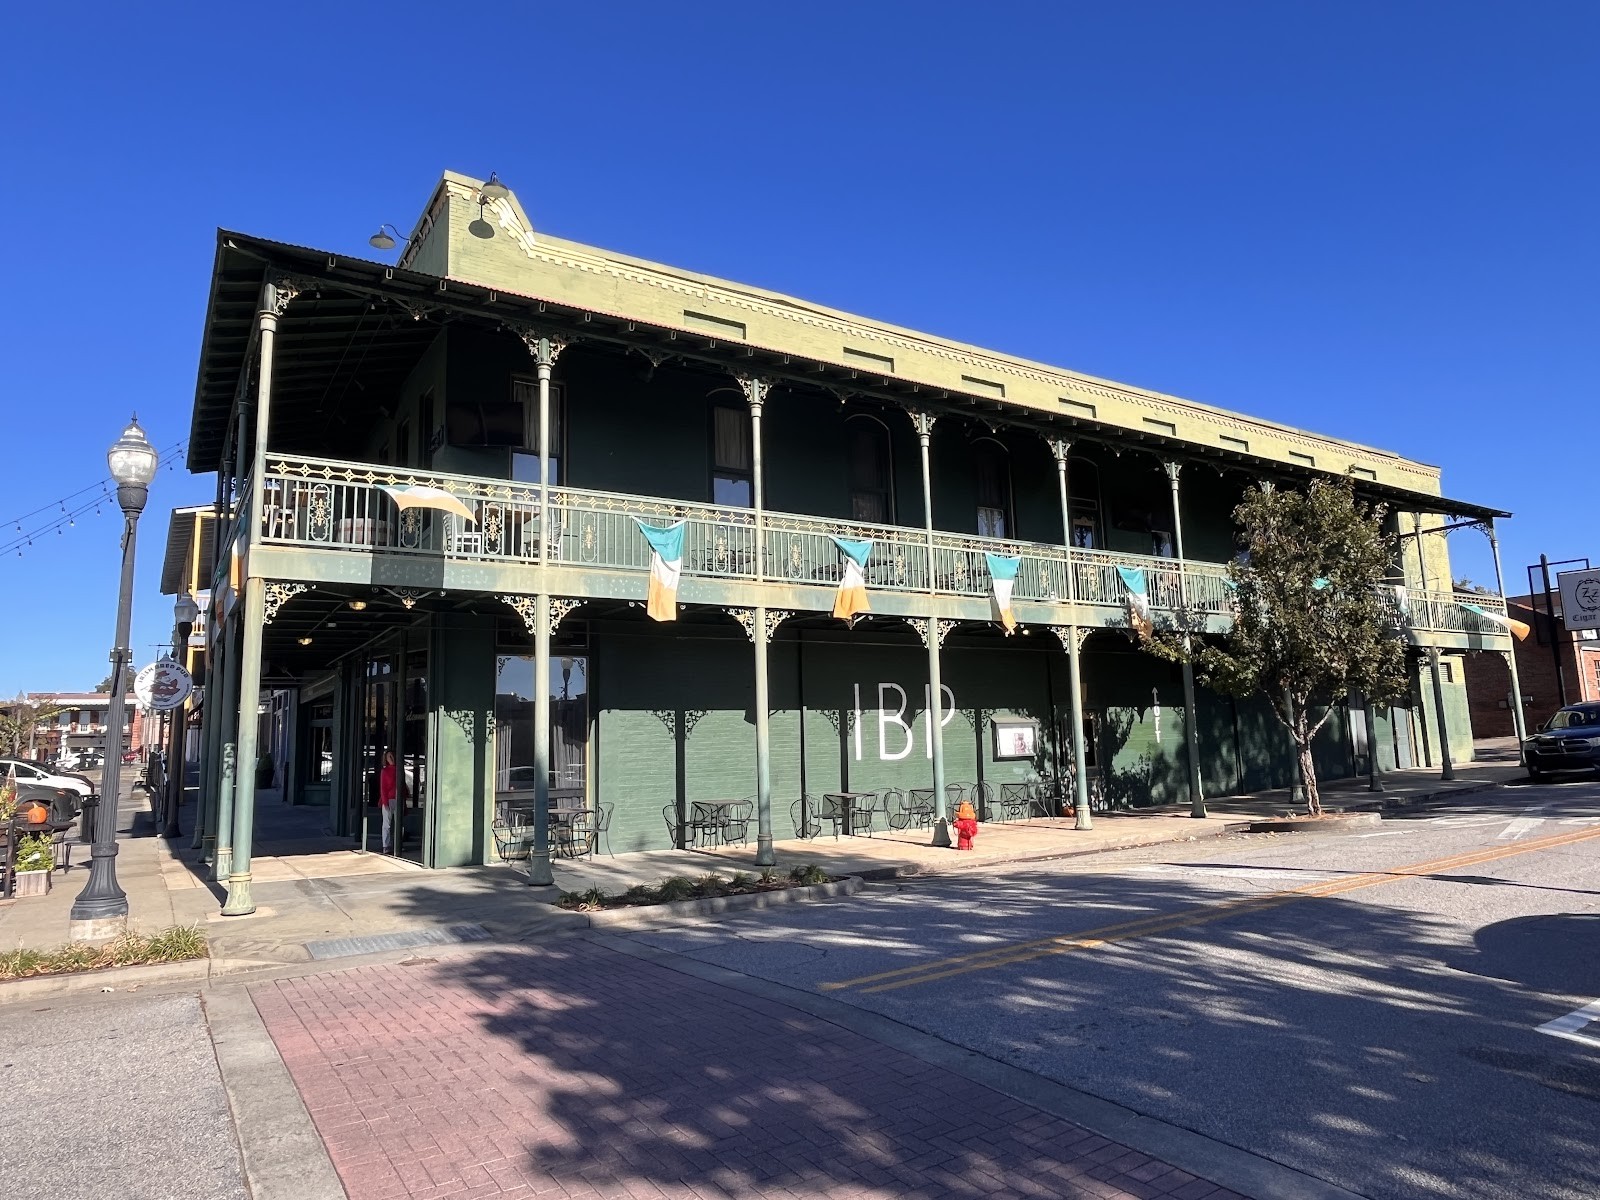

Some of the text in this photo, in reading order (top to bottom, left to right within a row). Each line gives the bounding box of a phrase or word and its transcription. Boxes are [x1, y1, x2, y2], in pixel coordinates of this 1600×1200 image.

[1572, 614, 1597, 623] Cigar
[138, 666, 154, 683] IRISH
[175, 666, 190, 678] PUB
[853, 683, 956, 761] IBP
[1152, 688, 1161, 743] LOFT
